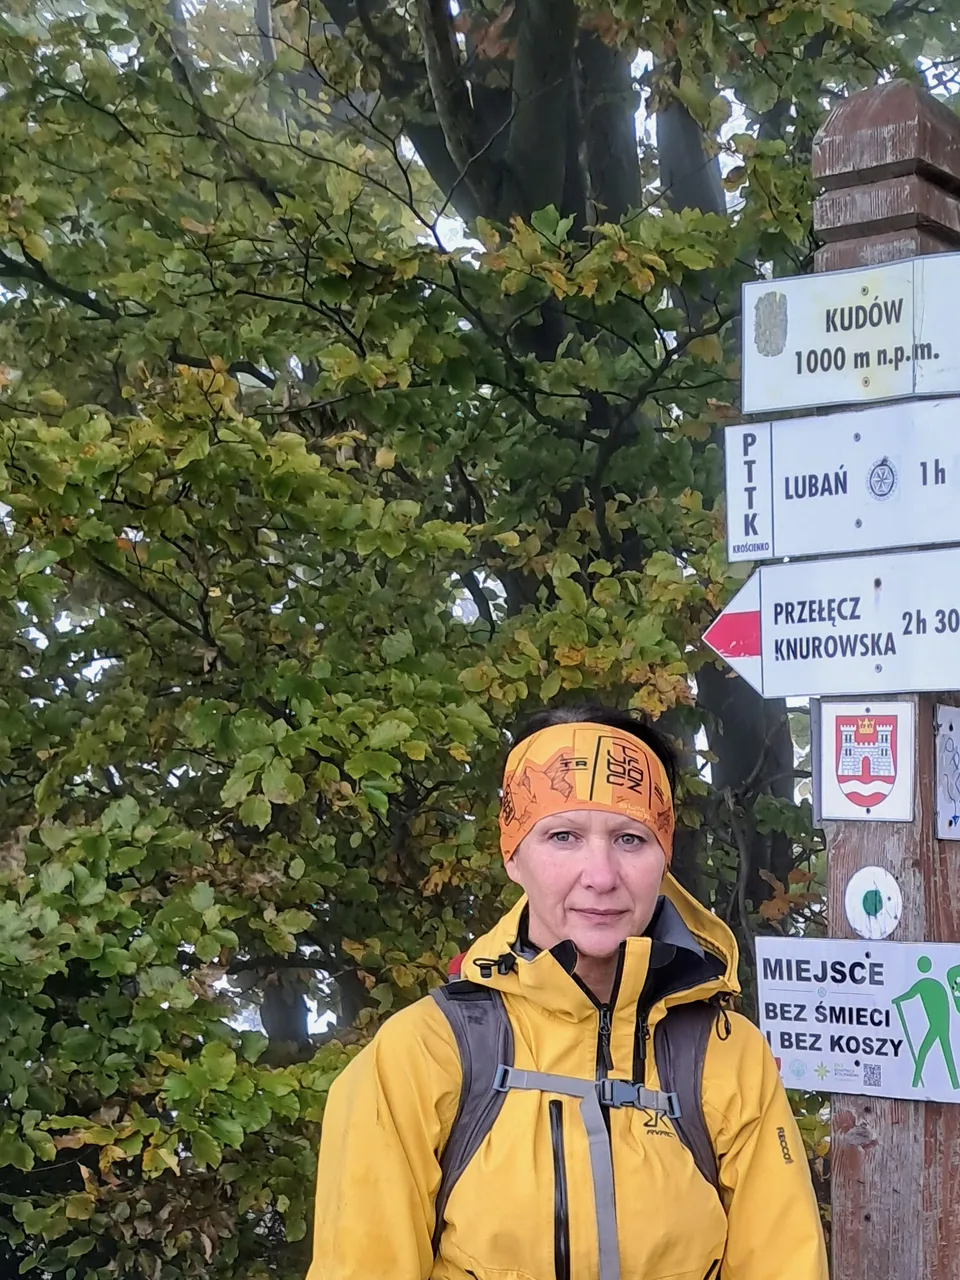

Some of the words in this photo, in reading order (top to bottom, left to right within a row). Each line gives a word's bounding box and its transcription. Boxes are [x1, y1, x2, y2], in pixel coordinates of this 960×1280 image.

[825, 295, 904, 333] KUDÓW
[795, 346, 846, 375] 1000
[853, 351, 870, 369] m
[877, 342, 940, 371] n.p.m.
[742, 432, 759, 537] PTTK
[784, 463, 848, 501] LUBAŃ
[732, 541, 770, 554] KROŚCIENKO
[773, 596, 861, 628] PRZEŁĘCZ
[901, 608, 927, 636] 2h
[934, 608, 960, 634] 30
[774, 631, 897, 662] KNUROWSKA
[762, 957, 885, 986] MIEJSCE
[764, 1002, 808, 1022] BEZ
[814, 1000, 890, 1027] ŚMIECI
[779, 1031, 823, 1052] BEZ
[829, 1034, 904, 1058] KOSZY
